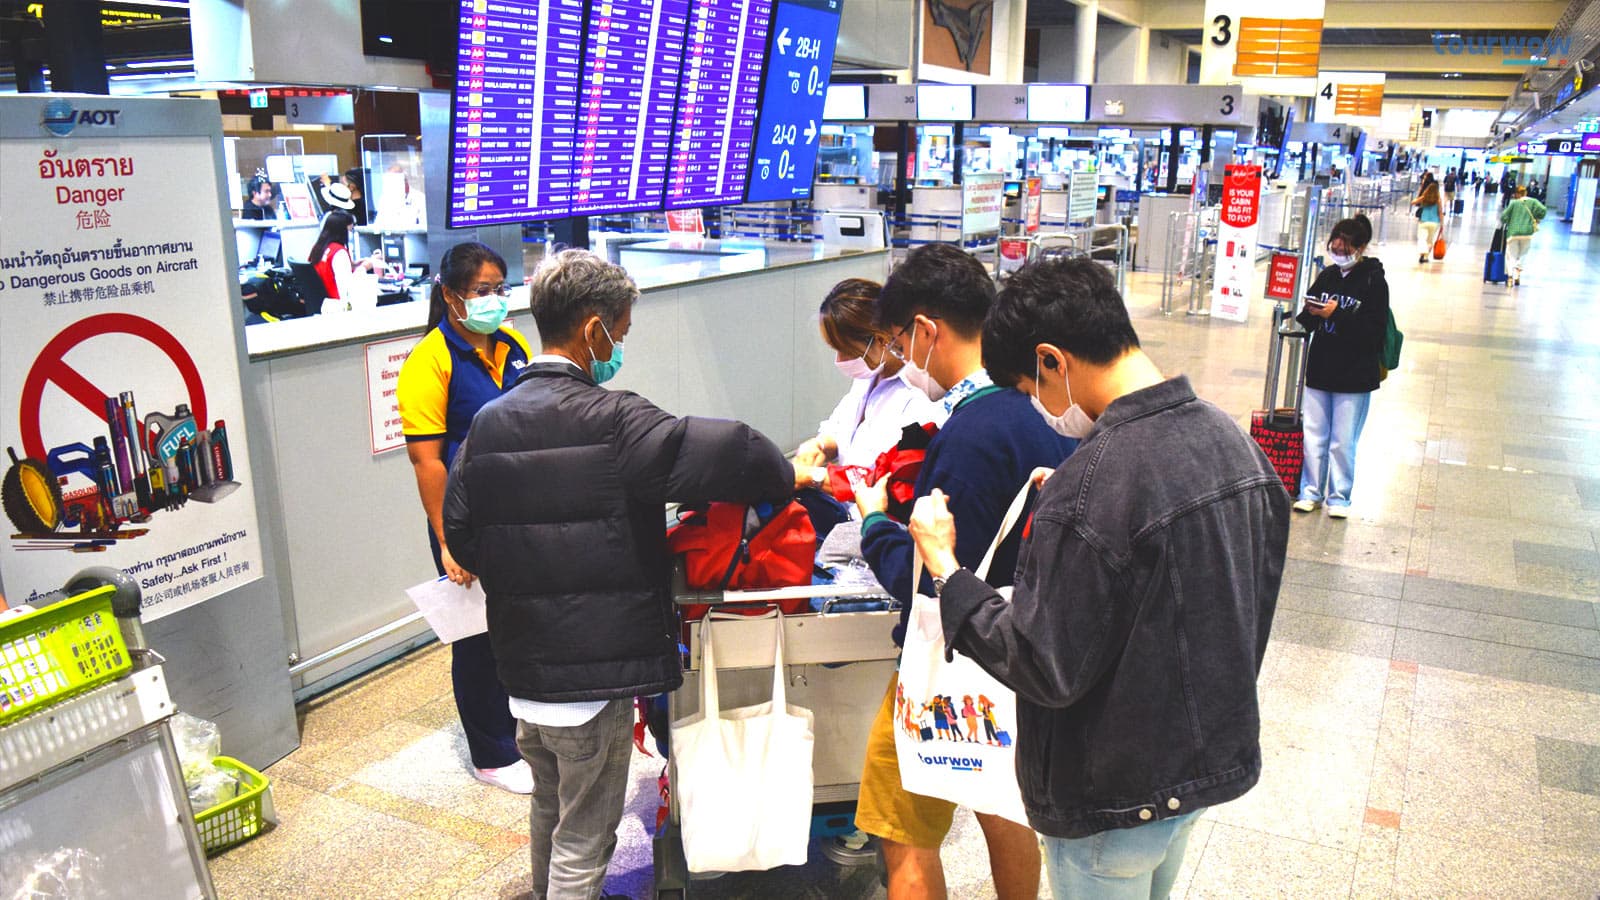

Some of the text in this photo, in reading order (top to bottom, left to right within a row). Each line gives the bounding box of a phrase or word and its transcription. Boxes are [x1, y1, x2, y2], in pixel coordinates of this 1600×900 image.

[1211, 14, 1231, 46] 3
[795, 36, 821, 60] 2B-H
[807, 65, 819, 96] 0
[904, 96, 915, 104] 3G
[1014, 96, 1025, 104] 3H
[1321, 82, 1333, 100] 4
[292, 103, 299, 118] 3
[1220, 95, 1234, 115] 3
[78, 110, 120, 127] AOT
[771, 124, 797, 146] 2J-Q
[1332, 127, 1341, 139] 4
[1378, 141, 1385, 149] 5
[38, 149, 134, 179] อันตราย
[778, 149, 790, 179] 0
[56, 186, 126, 206] Danger
[1230, 197, 1251, 206] CABIN
[1236, 189, 1254, 198] YOUR
[76, 209, 111, 231] 危险
[1227, 213, 1252, 223] TO FLY?
[1228, 206, 1252, 215] BAG FIT
[0, 239, 193, 270] ามนำวัตถุอันตรายขึ้นอากาศยาน
[11, 272, 85, 289] Dangerous
[90, 265, 132, 281] Goods
[137, 265, 152, 275] on
[156, 258, 198, 274] Aircraft
[43, 280, 155, 306] 禁止携带危险品乘机
[162, 425, 194, 459] FUEL
[156, 529, 247, 567] กรุณาสอบถามพนักงาน
[201, 554, 222, 570] First
[141, 561, 250, 609] 空公司或机场客服人员咨询
